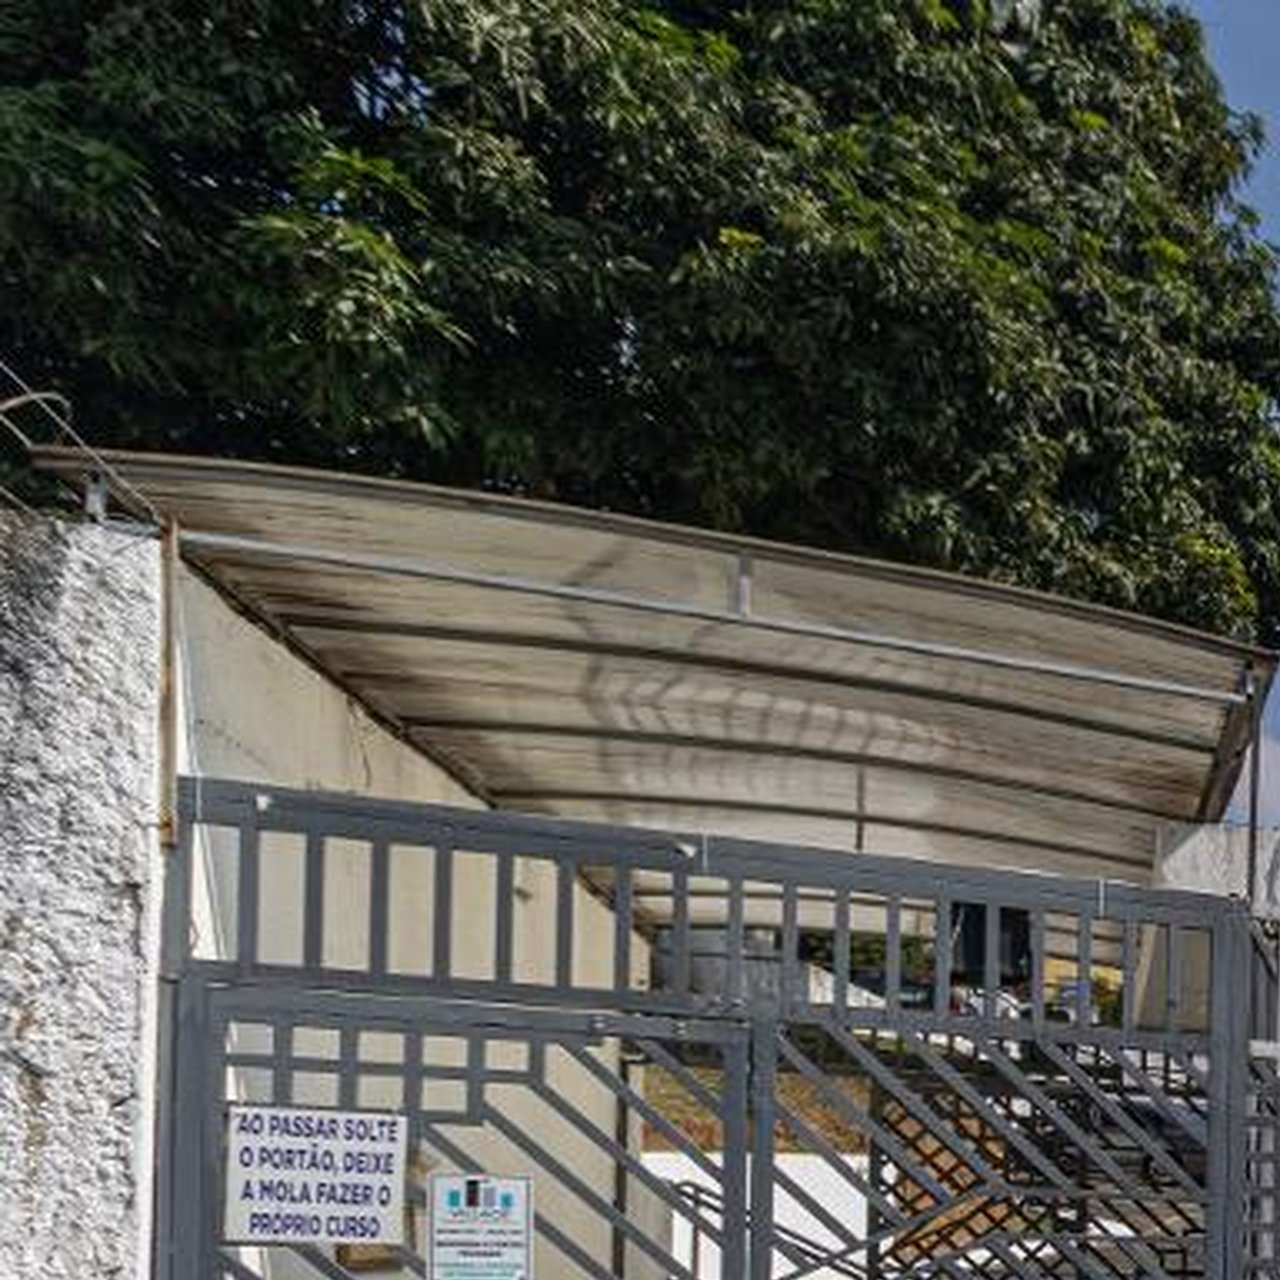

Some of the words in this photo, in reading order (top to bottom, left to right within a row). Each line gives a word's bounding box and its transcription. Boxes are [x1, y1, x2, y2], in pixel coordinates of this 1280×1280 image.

[238, 1113, 264, 1135] AO
[269, 1115, 339, 1140] PASSAR
[344, 1119, 398, 1142] SOLTE
[239, 1146, 254, 1168] O
[258, 1143, 338, 1176] PORTÃO,
[343, 1152, 395, 1175] DEIXE
[241, 1180, 254, 1200] A
[258, 1180, 312, 1203] MOLA
[316, 1183, 373, 1206] FAZER
[378, 1185, 392, 1207] O
[326, 1216, 381, 1239] CURSO
